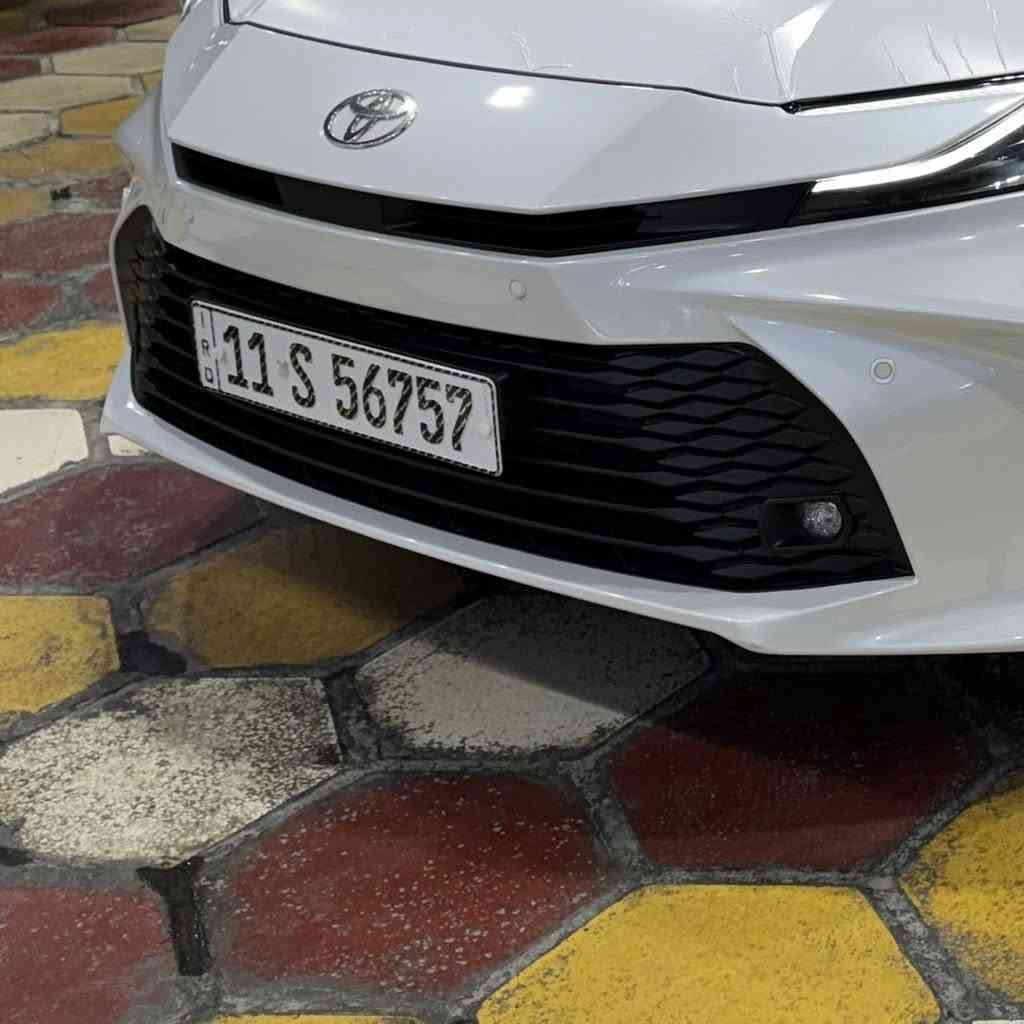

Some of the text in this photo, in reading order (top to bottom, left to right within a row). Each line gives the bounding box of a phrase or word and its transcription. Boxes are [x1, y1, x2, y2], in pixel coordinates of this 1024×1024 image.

[223, 325, 473, 452] 11 S 56757
